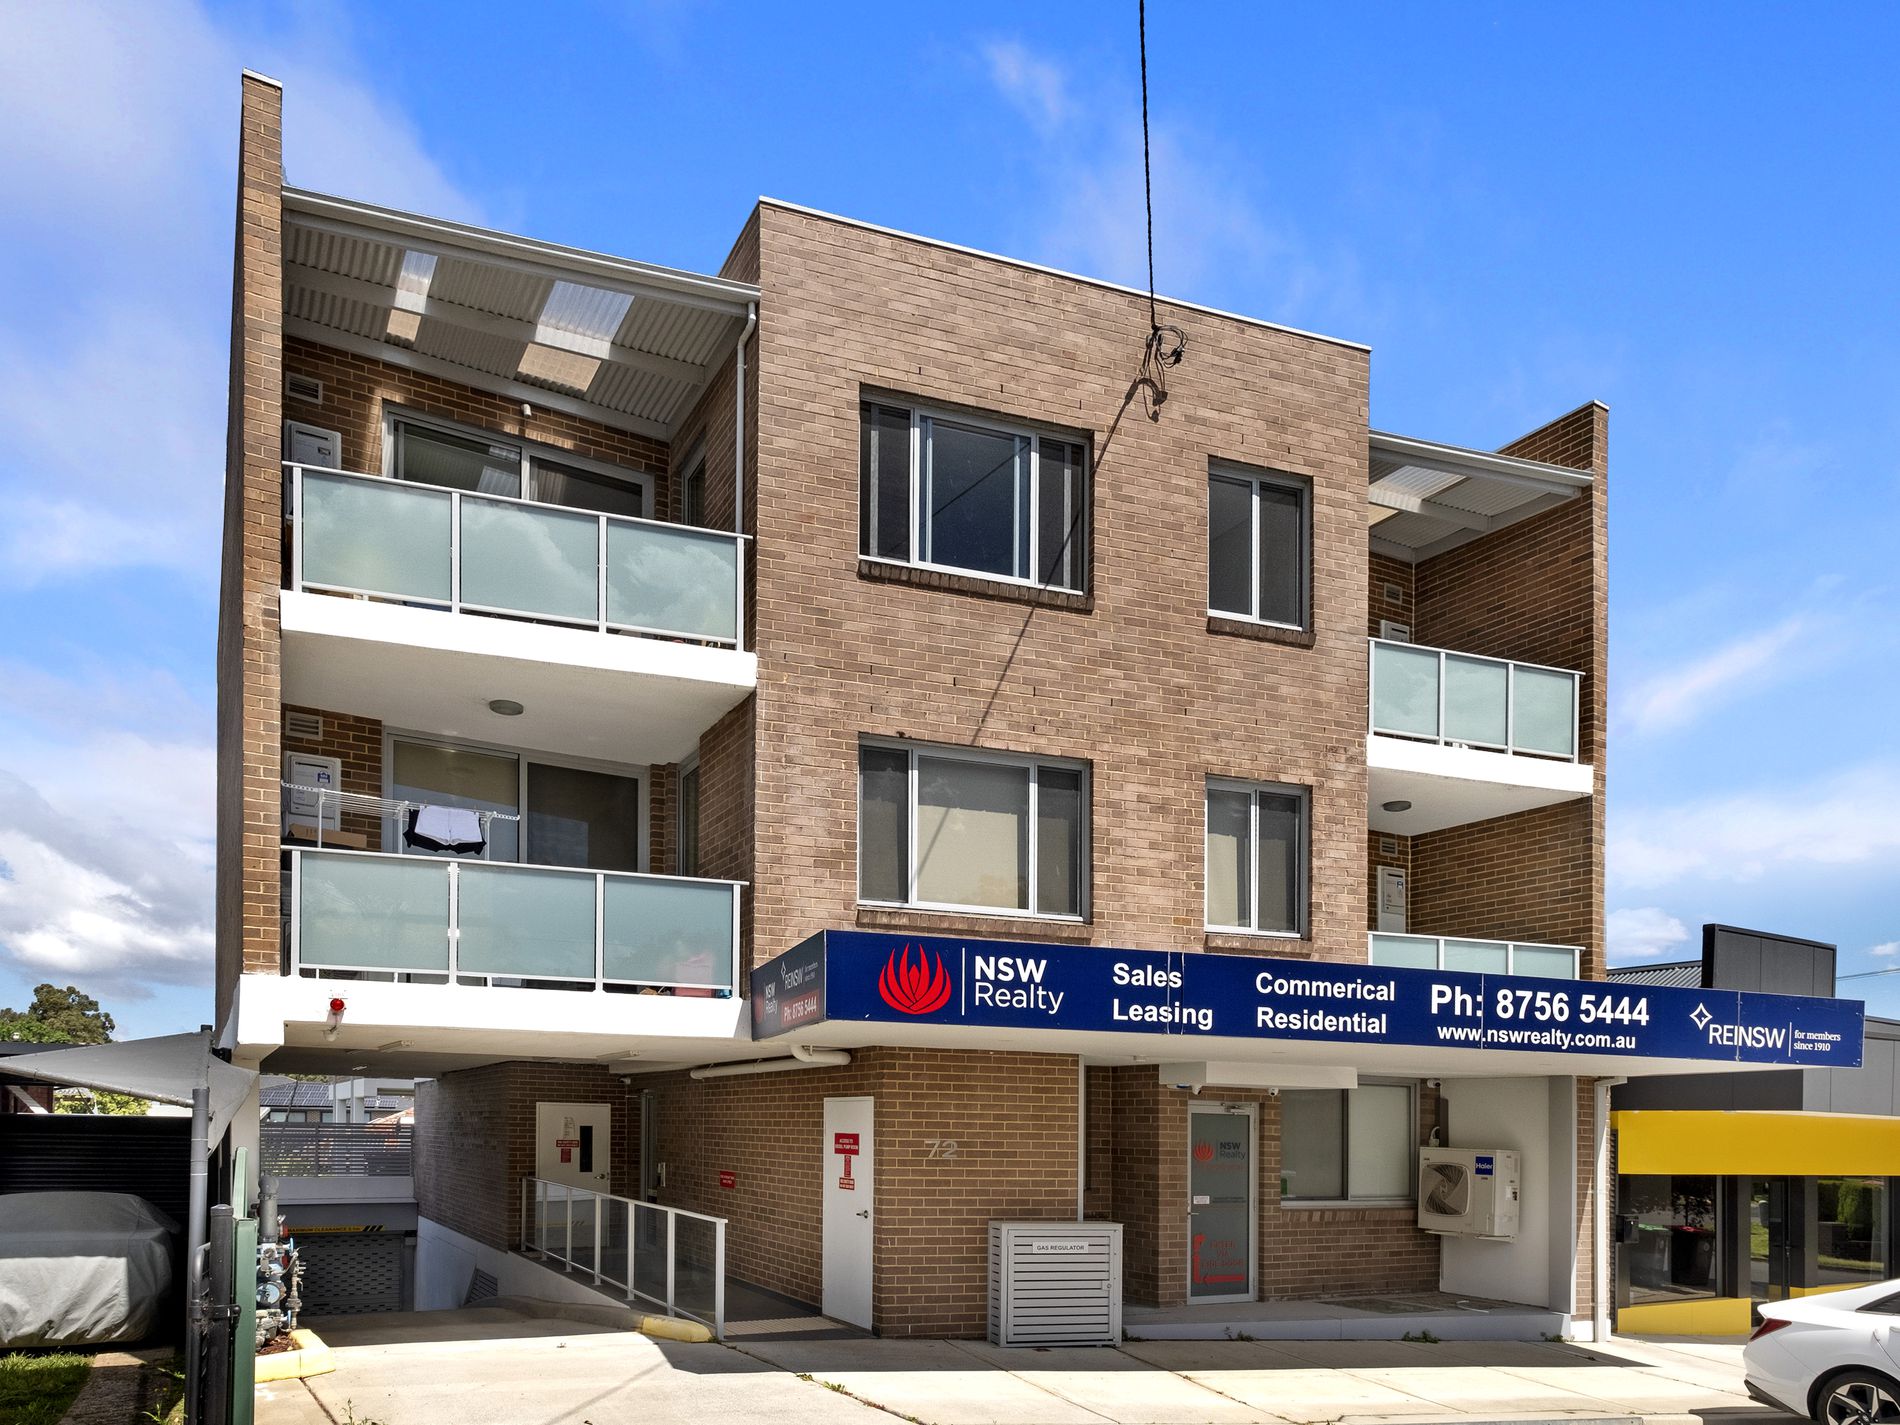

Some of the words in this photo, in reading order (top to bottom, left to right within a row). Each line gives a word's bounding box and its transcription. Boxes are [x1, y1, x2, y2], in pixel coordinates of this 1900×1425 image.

[974, 956, 1047, 984] NSW
[1113, 962, 1182, 988] Sales
[975, 982, 1064, 1015] Realty
[1256, 972, 1395, 1001] Commerical
[804, 996, 817, 1014] 5444
[1113, 998, 1213, 1030] Leasing
[1431, 984, 1482, 1017] Ph:
[1496, 988, 1570, 1022] 8756
[1580, 994, 1650, 1026] 5444
[1256, 1006, 1386, 1034] Residential
[1437, 1026, 1636, 1050] www.nswrealty.com.au
[1709, 1024, 1786, 1048] REINSW
[1794, 1030, 1805, 1040] for
[1806, 1031, 1841, 1042] members
[1794, 1042, 1814, 1050] since
[1814, 1042, 1830, 1052] 1910
[925, 1140, 958, 1158] 72
[1220, 1142, 1241, 1150] NSW
[1220, 1150, 1246, 1160] Realty
